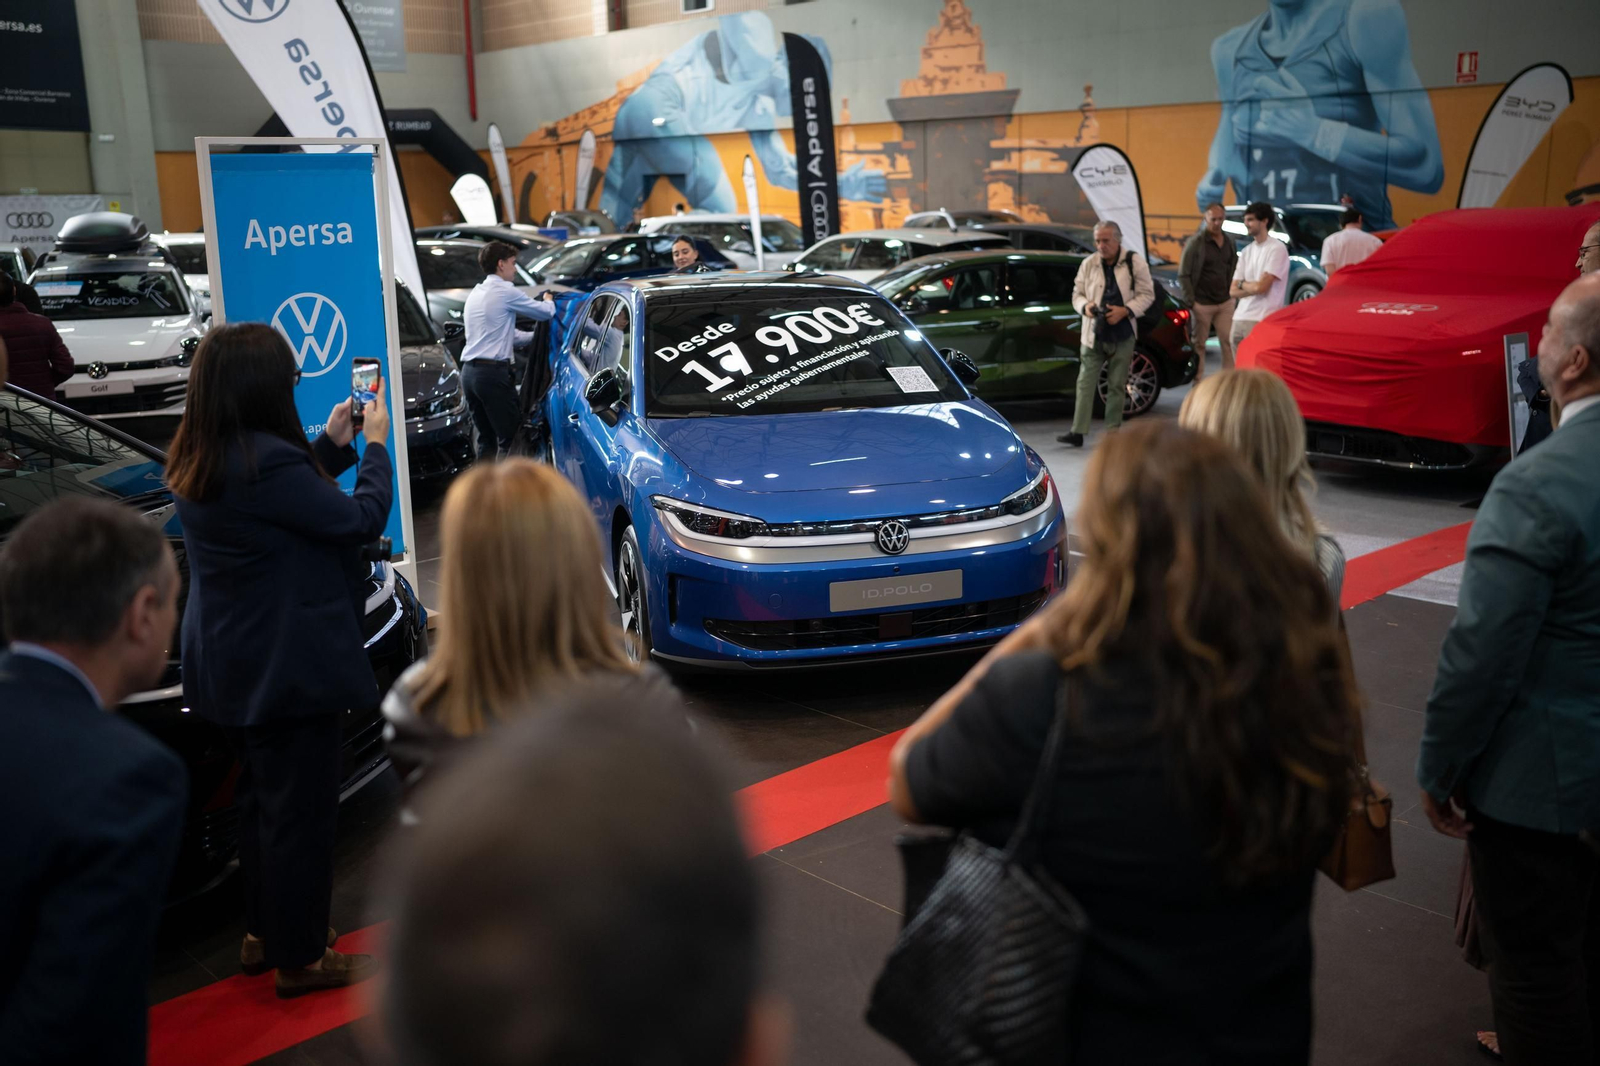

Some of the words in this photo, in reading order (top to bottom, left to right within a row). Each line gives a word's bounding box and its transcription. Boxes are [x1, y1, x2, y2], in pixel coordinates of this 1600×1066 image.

[1504, 95, 1556, 113] BYD
[802, 77, 824, 178] Apersa
[1262, 168, 1298, 199] 17
[11, 234, 54, 243] Apersa
[244, 218, 353, 256] Apersa
[87, 296, 139, 306] VENDIDO
[654, 322, 737, 363] Desde
[758, 367, 791, 386] sujeto
[790, 364, 799, 372] a
[796, 341, 854, 369] financiación
[858, 328, 900, 346] aplicando
[91, 384, 108, 393] Golf
[736, 396, 756, 409] las
[754, 379, 791, 401] ayudas
[790, 349, 870, 386] gubernamentales
[862, 582, 933, 600] ID.POLO
